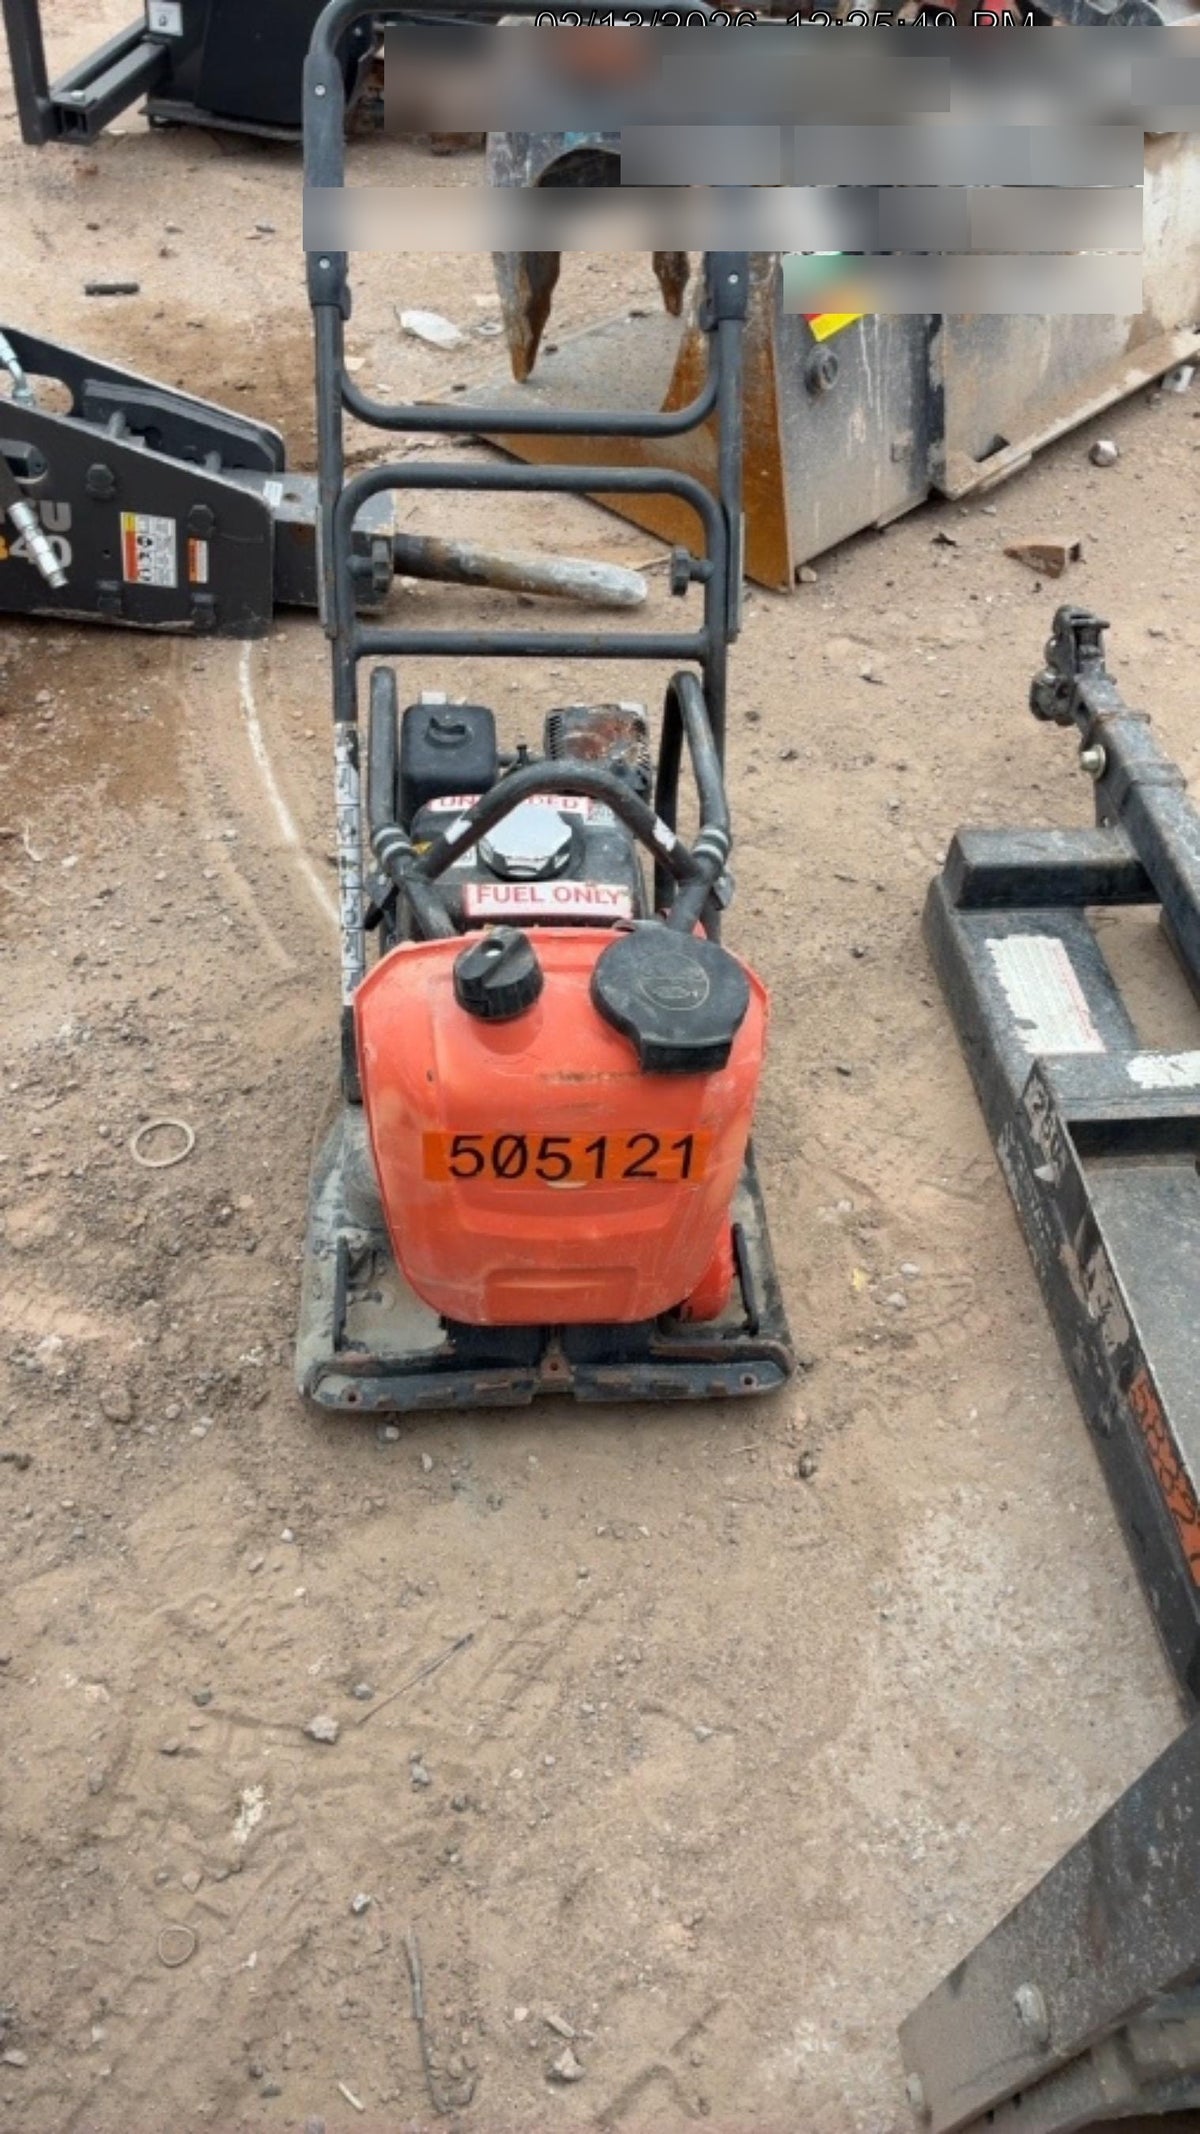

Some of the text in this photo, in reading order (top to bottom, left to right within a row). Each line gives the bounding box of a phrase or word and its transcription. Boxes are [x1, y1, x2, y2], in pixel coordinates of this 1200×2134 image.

[475, 886, 621, 905] FUEL ONLY
[448, 1133, 695, 1181] 505121
